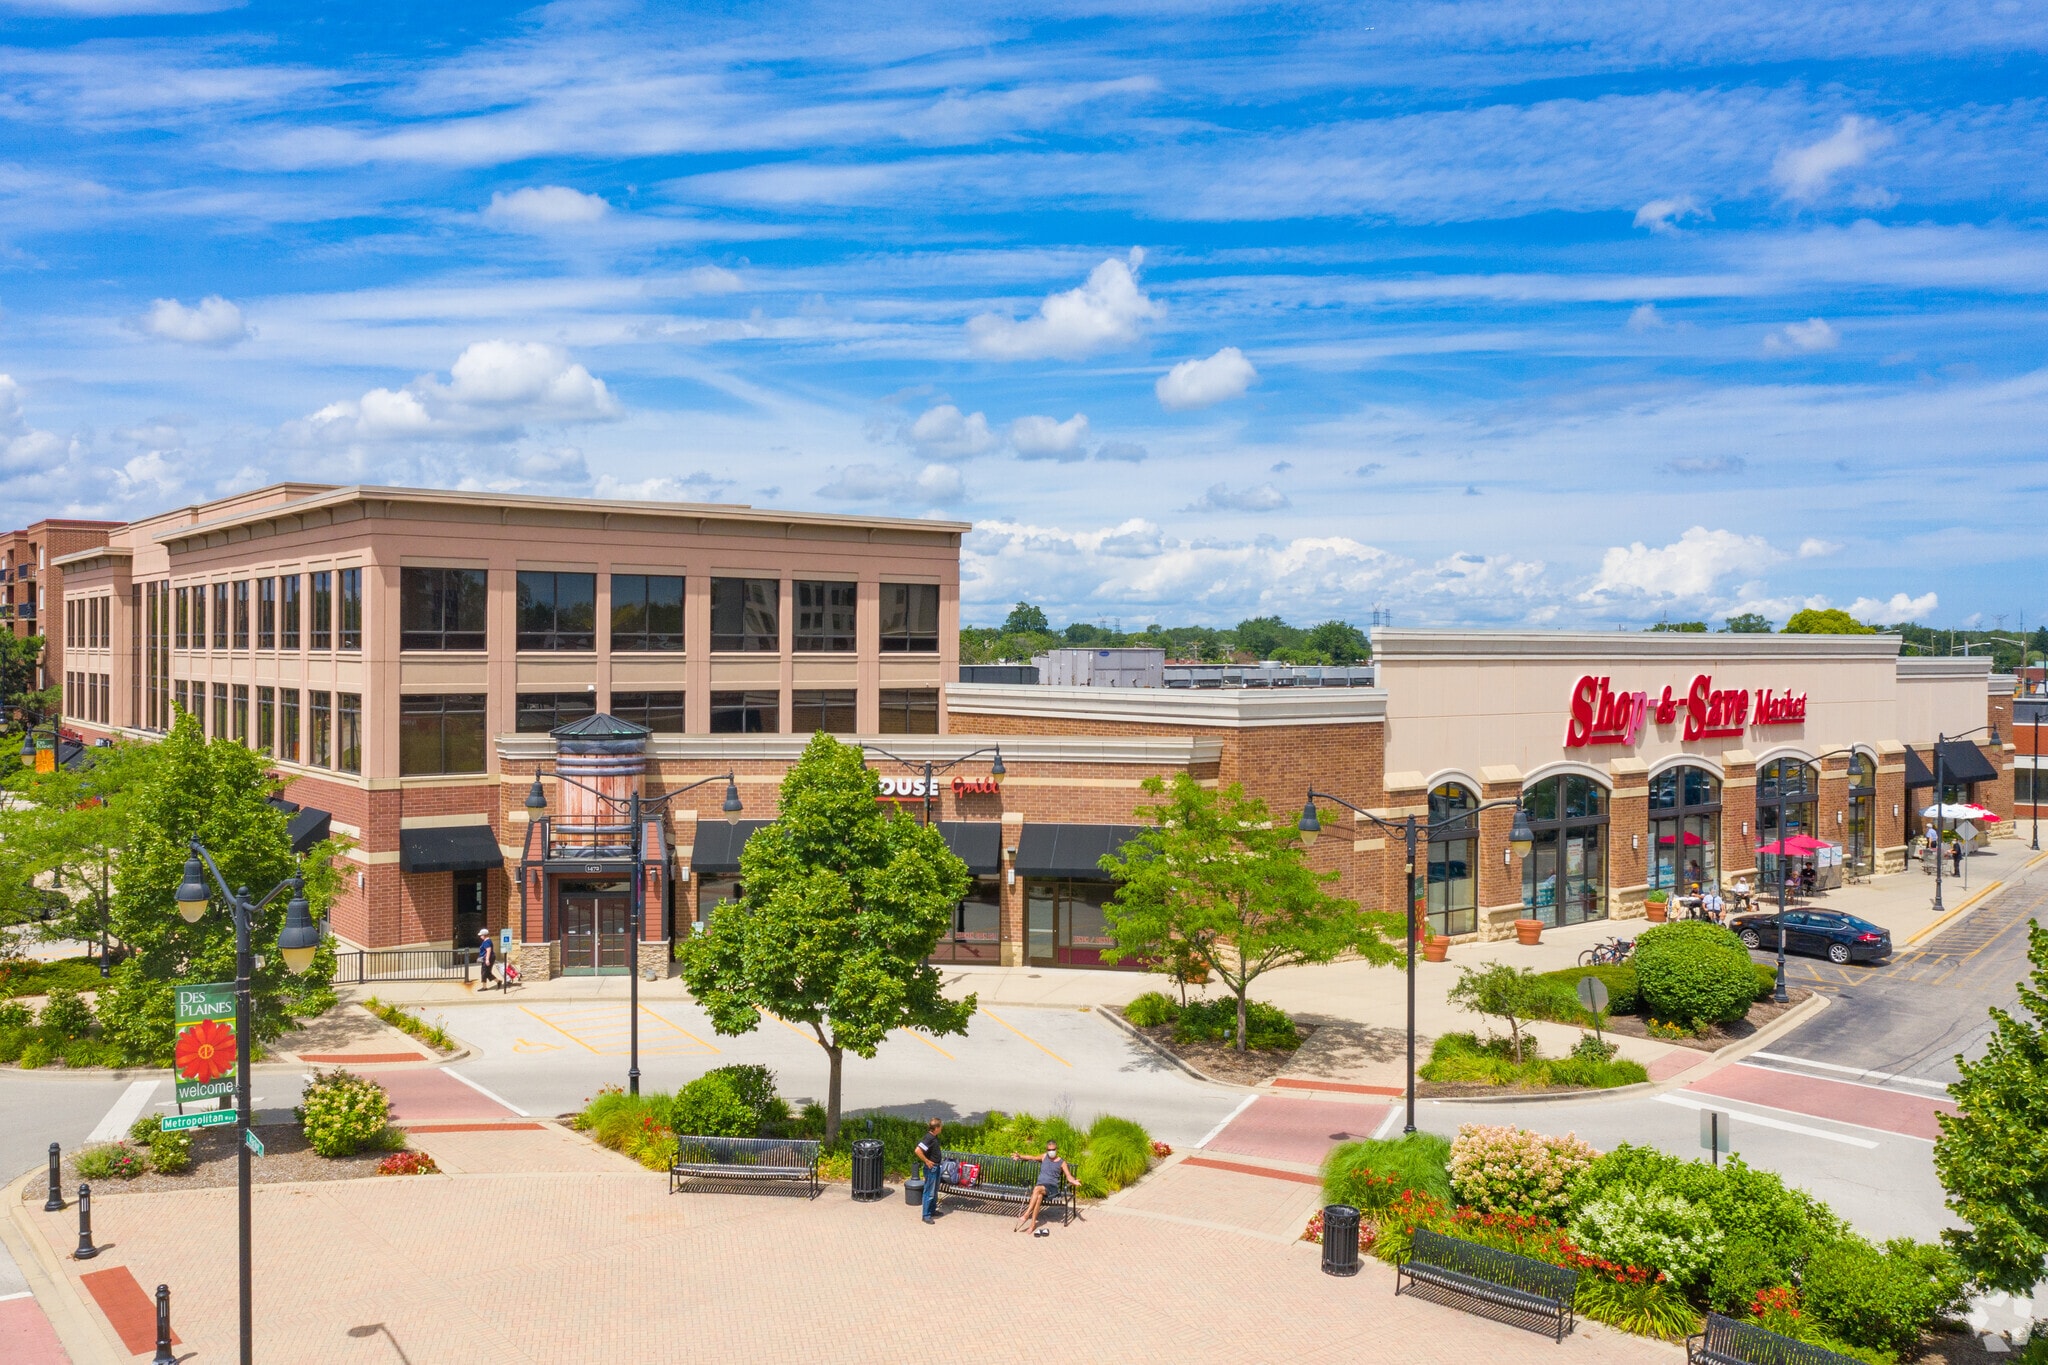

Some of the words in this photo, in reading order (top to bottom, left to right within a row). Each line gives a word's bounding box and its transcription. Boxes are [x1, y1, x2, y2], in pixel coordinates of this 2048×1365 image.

[1752, 688, 1807, 725] Market
[878, 778, 939, 796] OUSE
[950, 776, 1000, 798] Grill
[180, 992, 206, 1005] DES
[180, 1002, 232, 1017] PLAINES
[178, 1081, 234, 1099] welcome
[164, 1114, 224, 1129] Metropolitan
